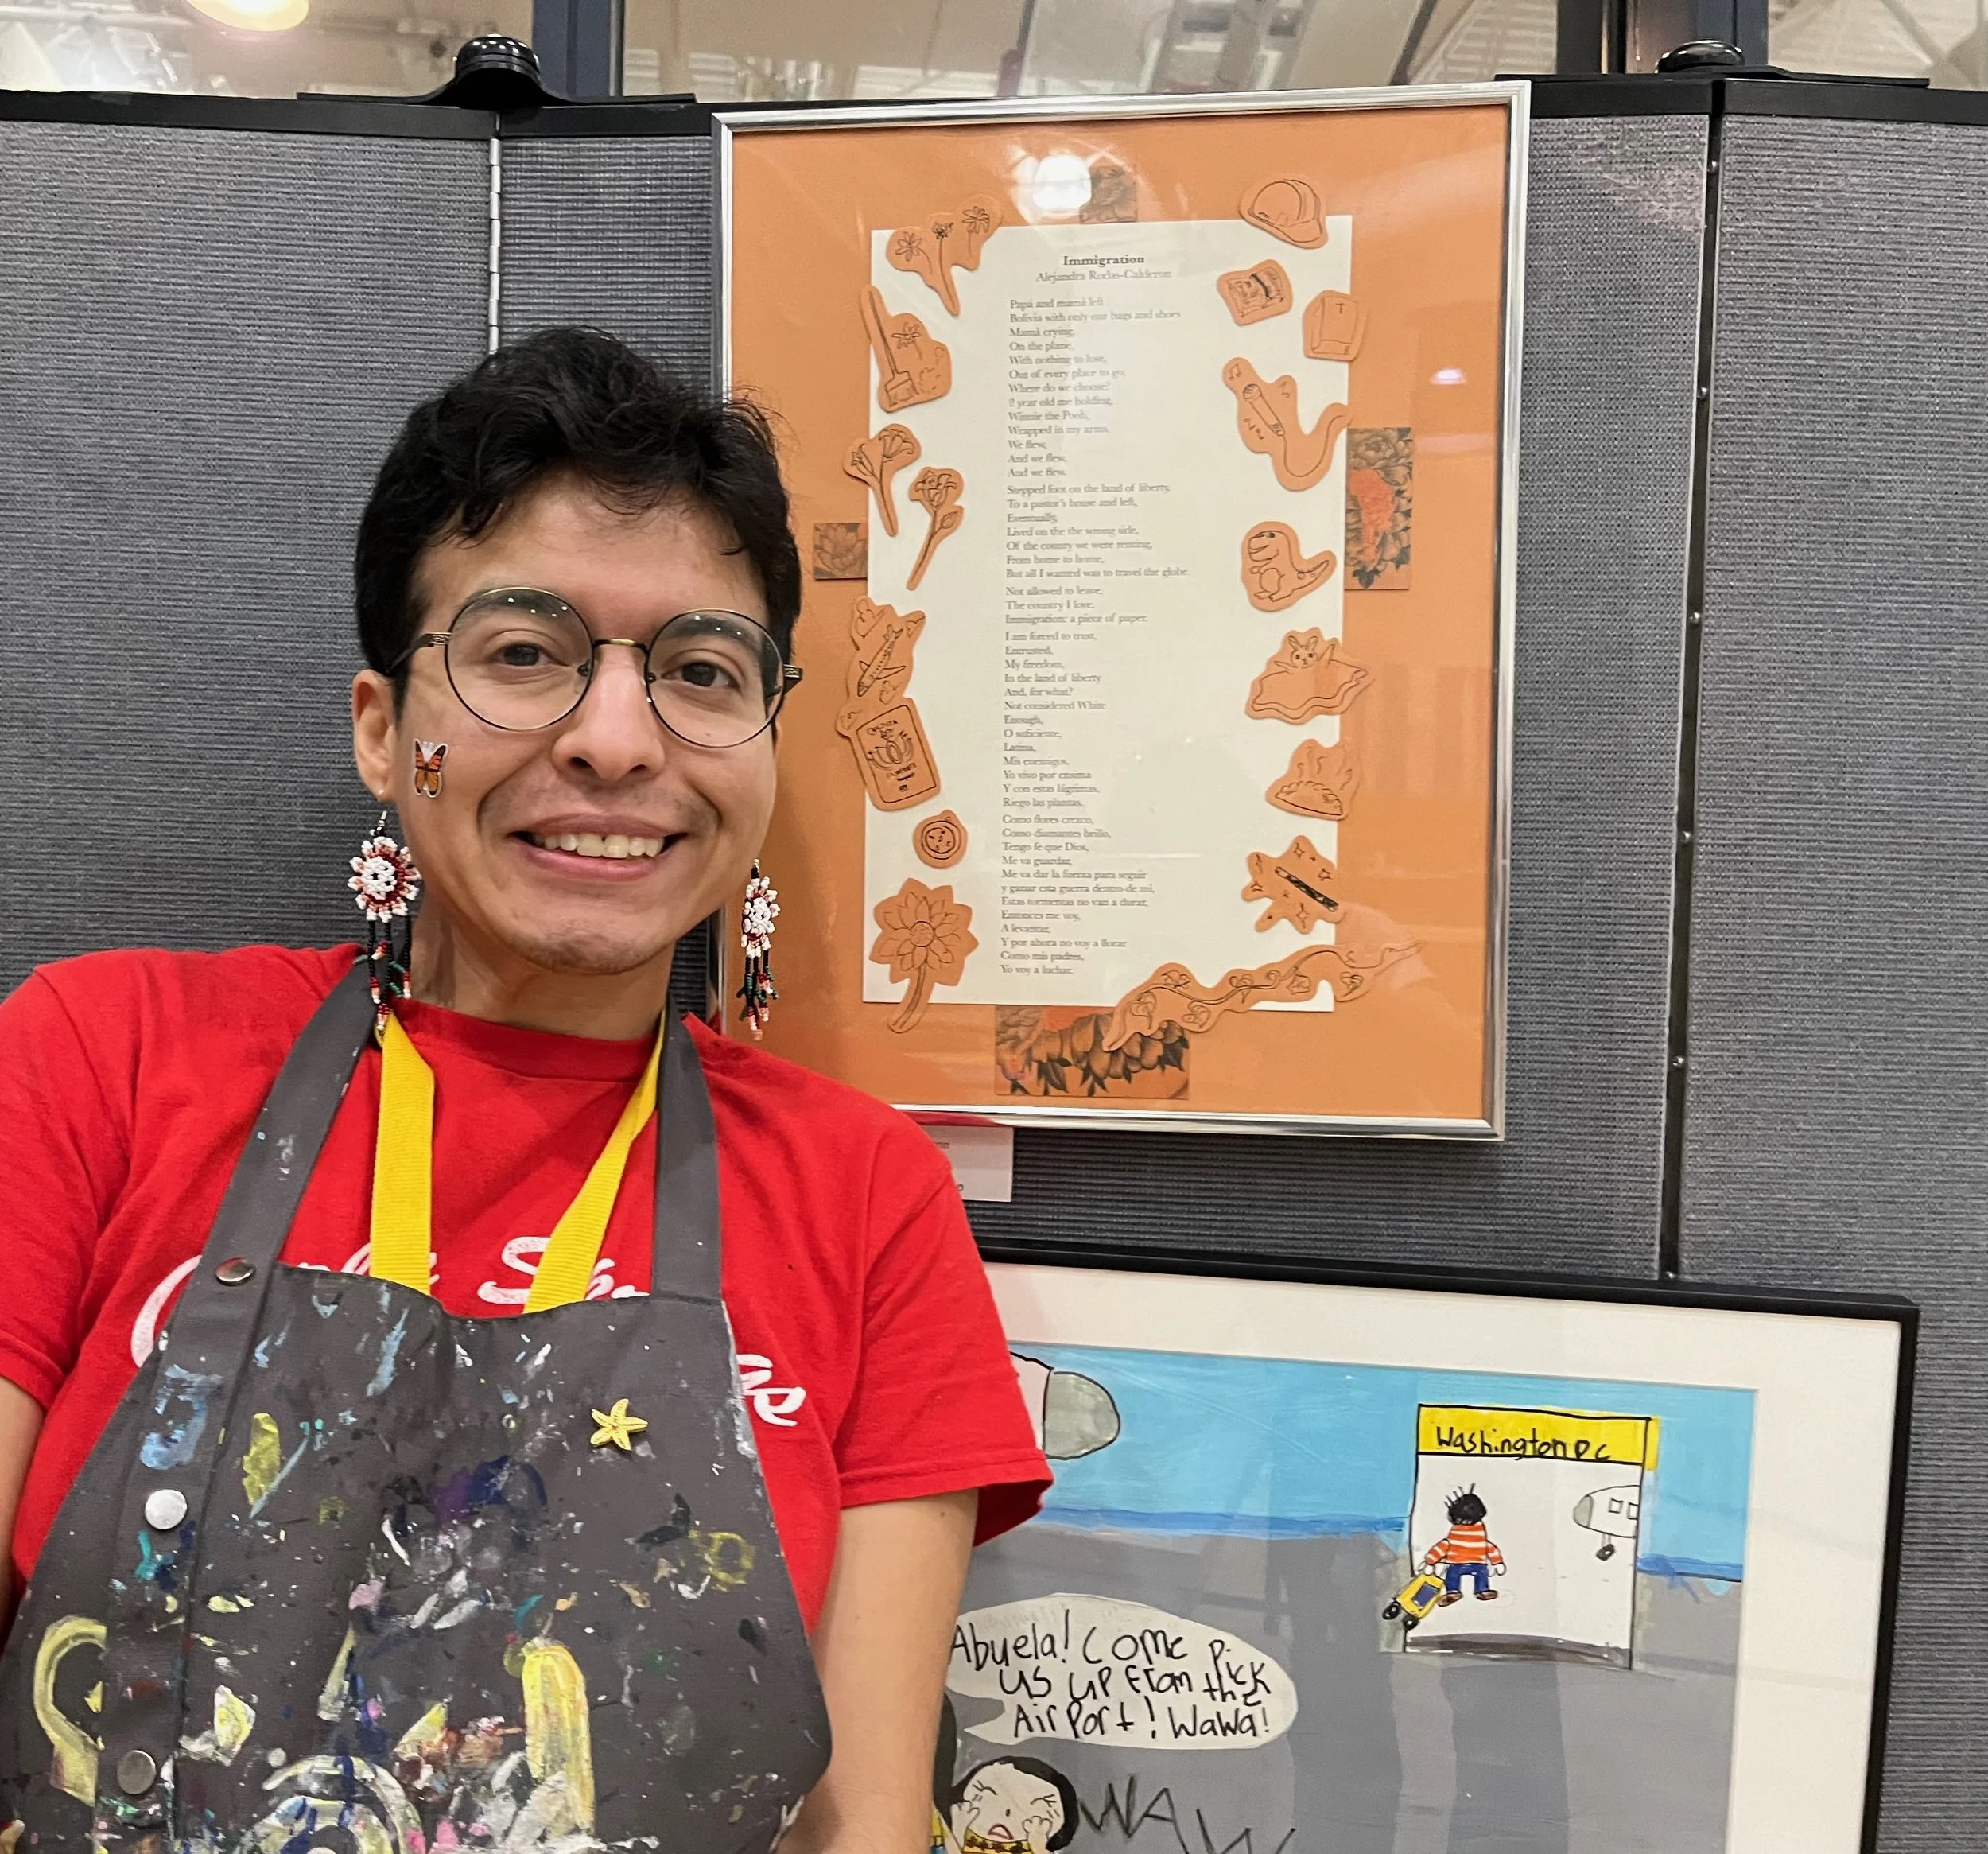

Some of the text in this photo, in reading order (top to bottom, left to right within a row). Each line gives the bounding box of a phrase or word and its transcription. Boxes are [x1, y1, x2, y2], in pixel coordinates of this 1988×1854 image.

[1063, 254, 1145, 267] Immigration
[1043, 383, 1056, 391] do
[1006, 499, 1020, 508] To
[1436, 1426, 1567, 1460] Washington
[952, 1608, 1070, 1671] Abuela!
